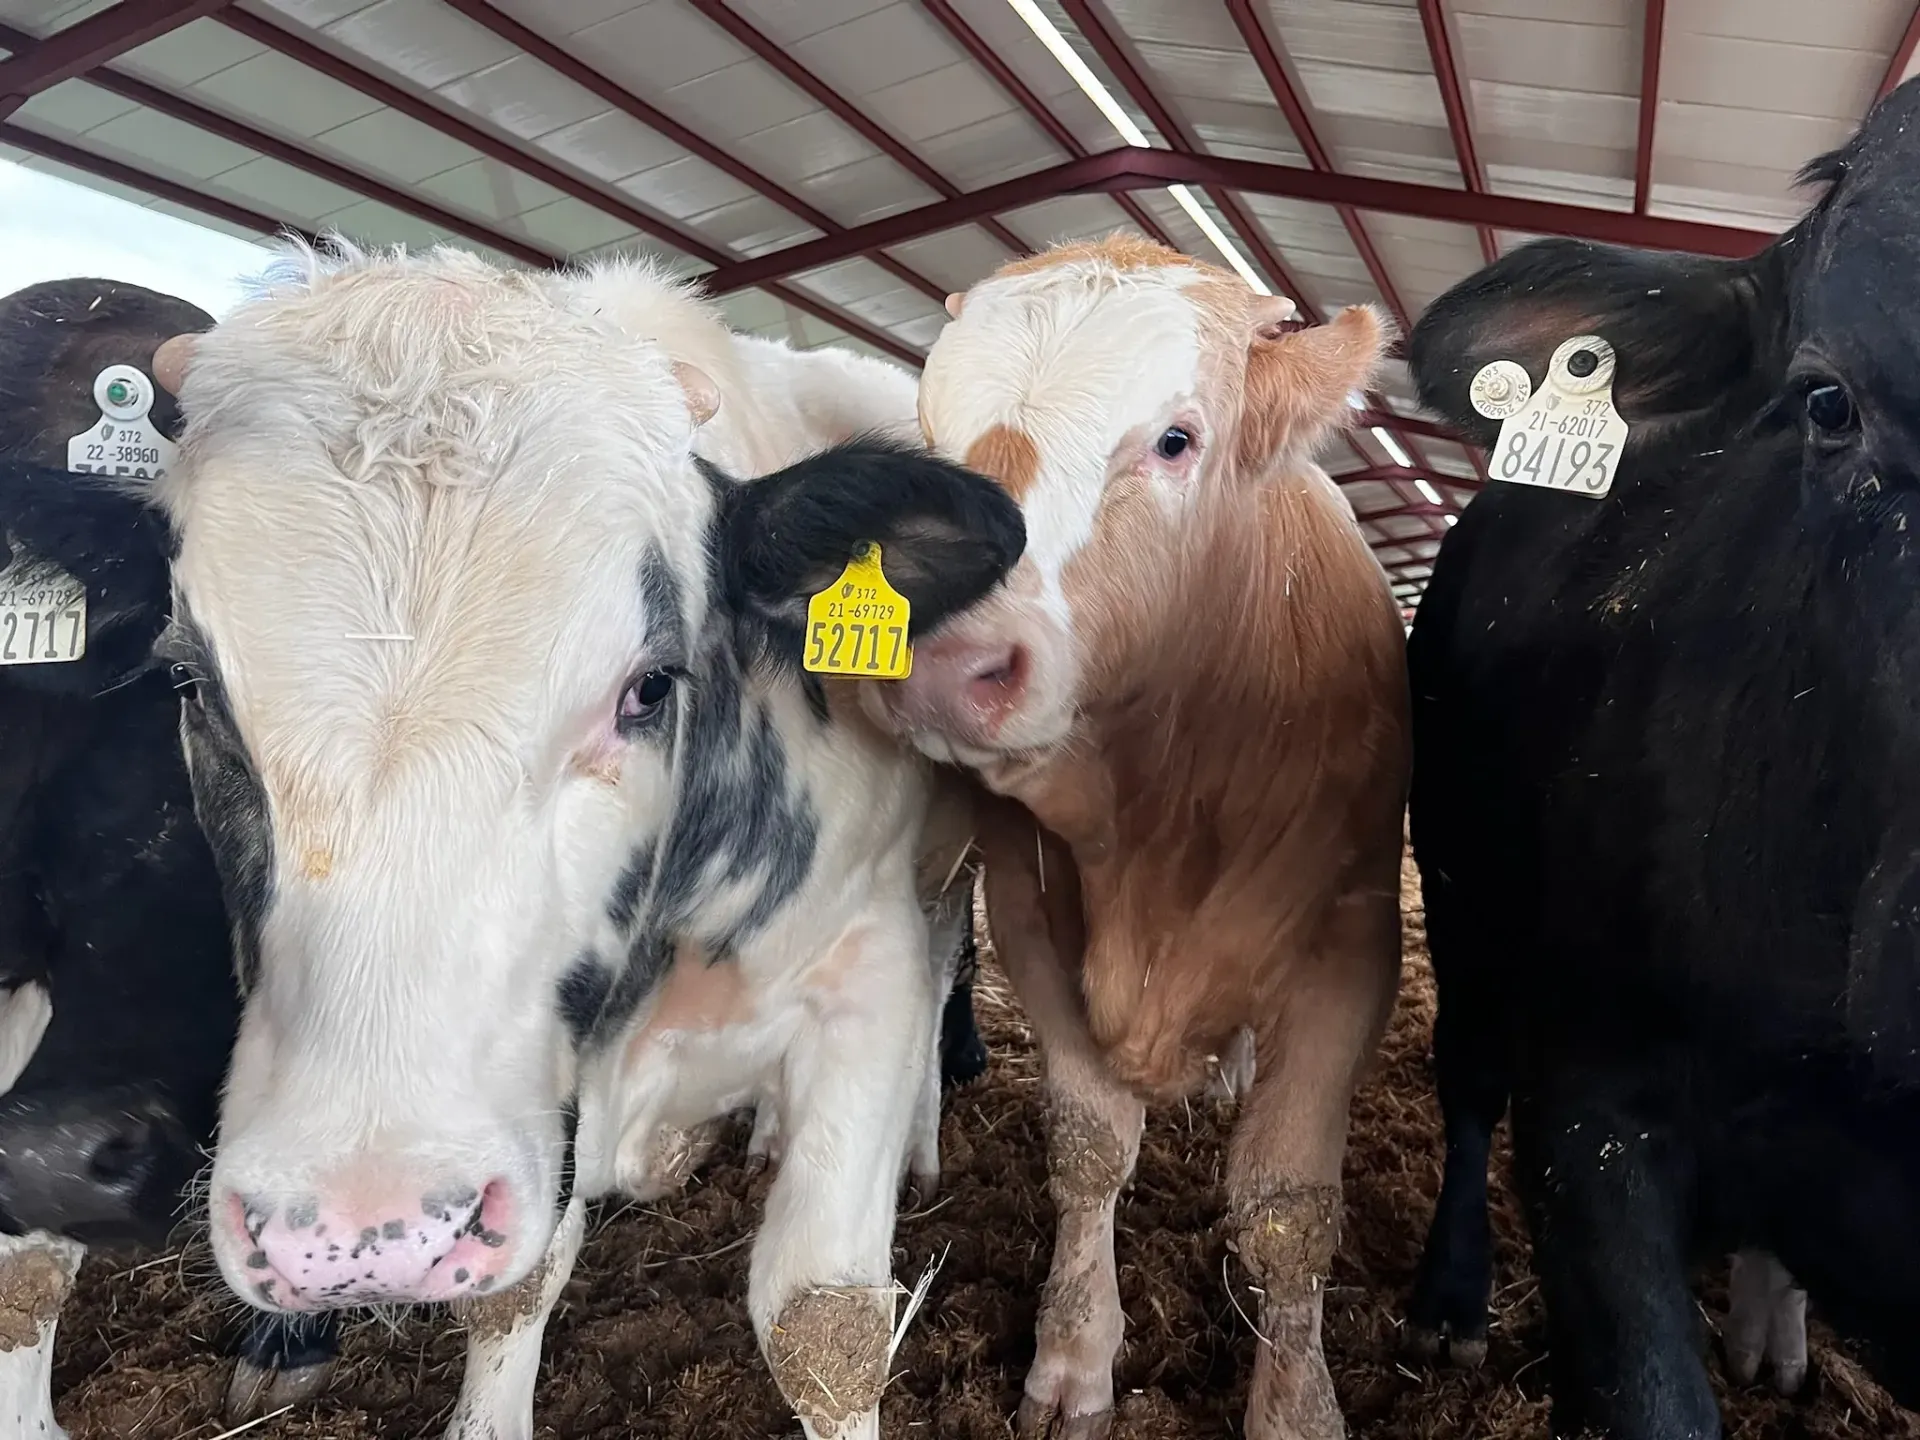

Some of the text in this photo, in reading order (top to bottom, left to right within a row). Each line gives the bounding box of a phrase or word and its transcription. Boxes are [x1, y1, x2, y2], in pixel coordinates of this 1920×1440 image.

[1475, 365, 1499, 392] 84193
[1583, 399, 1611, 417] 372
[119, 430, 142, 444] 372
[1528, 410, 1609, 440] 21-62017
[1501, 431, 1614, 490] 84193
[856, 588, 877, 600] 372
[809, 621, 903, 671] 52717
